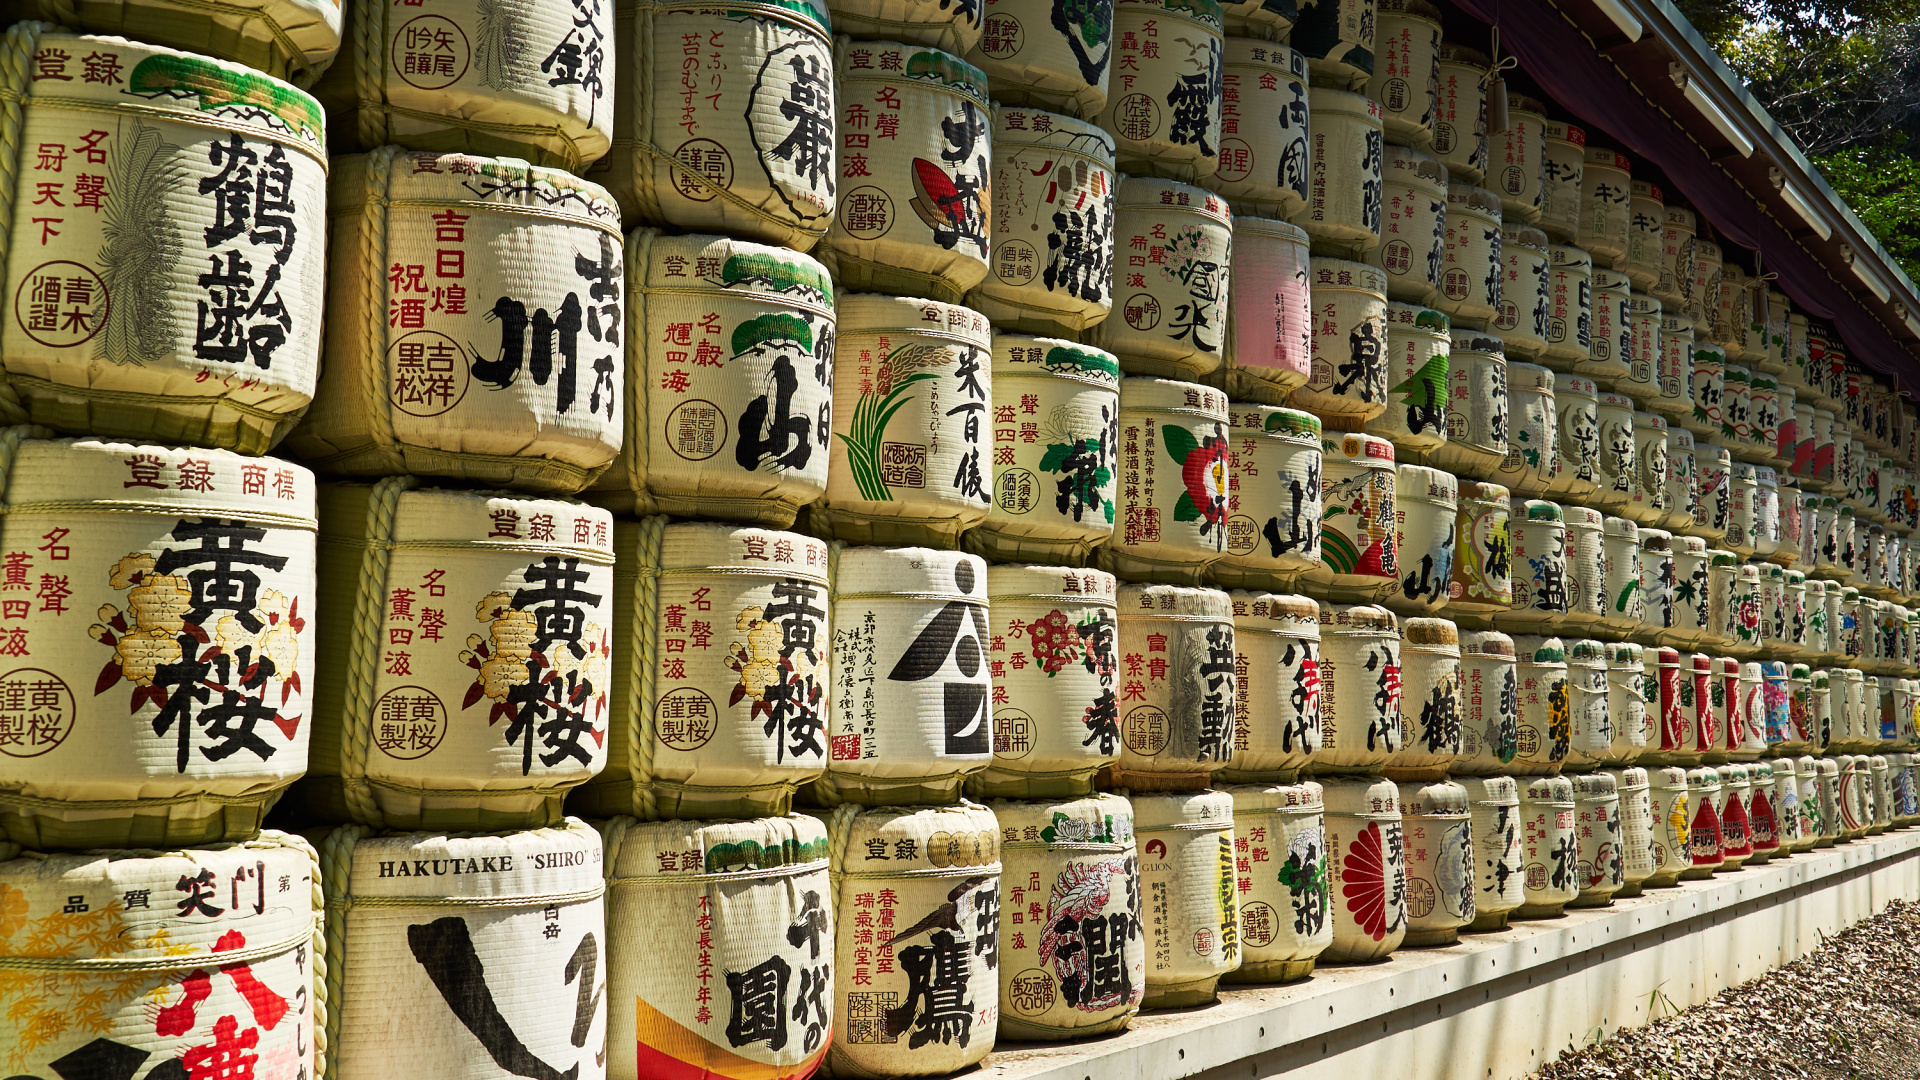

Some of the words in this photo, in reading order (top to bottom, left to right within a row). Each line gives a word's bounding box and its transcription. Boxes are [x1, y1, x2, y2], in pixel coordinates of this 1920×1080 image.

[432, 27, 456, 78] 矢尾
[1000, 19, 1019, 54] 鈴木
[31, 48, 124, 86] 登録
[849, 49, 904, 73] 登録
[1250, 47, 1285, 66] 登録
[1258, 72, 1278, 92] 金
[1004, 111, 1054, 133] 登録
[1121, 95, 1139, 140] 佐浦
[32, 143, 68, 246] 冠天下
[847, 194, 868, 231] 酒造
[868, 194, 887, 231] 牧野
[1159, 190, 1191, 206] 登録
[663, 255, 723, 279] 登録
[1000, 246, 1017, 279] 酒造
[1017, 247, 1034, 280] 柴崎
[1316, 268, 1353, 286] 登録
[28, 276, 59, 332] 酒造
[60, 276, 94, 334] 青木
[388, 262, 429, 329] 祝酒
[661, 322, 694, 394] 輝四海
[1008, 346, 1044, 364] 登録
[394, 342, 425, 406] 黒松
[422, 341, 457, 407] 吉祥
[735, 354, 813, 472] 山
[945, 344, 991, 504] 米百俵
[1241, 440, 1259, 477] 芳名
[1001, 472, 1017, 510] 酒造
[1017, 471, 1032, 513] 久須美
[1123, 425, 1140, 546] 雪椿酒造株式会社
[1239, 521, 1255, 550] 妙高
[1139, 593, 1177, 610] 登録
[1232, 601, 1270, 617] 登録
[1516, 582, 1529, 605] 大洋
[1319, 611, 1352, 626] 登録
[152, 517, 289, 773] 黄桜
[1007, 619, 1030, 671] 芳香
[1145, 632, 1170, 681] 富貴
[505, 556, 603, 776] 黄桜
[763, 578, 826, 765] 黄桜
[27, 679, 65, 747] 黄桜
[1235, 652, 1251, 751] 太田酒造株式会社
[1470, 669, 1484, 721] 長生自得
[379, 695, 409, 751] 謹製
[407, 695, 440, 751] 黄桜
[661, 695, 686, 744] 謹製
[685, 694, 711, 744] 黄桜
[1526, 729, 1538, 753] 多胡
[1594, 807, 1608, 822] 酒
[865, 838, 919, 861] 登録
[1002, 825, 1041, 844] 登録
[1693, 834, 1716, 847] FUJI
[378, 854, 514, 878] HAKUTAKE
[656, 850, 705, 873] 登録
[176, 860, 266, 918] 笑門
[543, 903, 562, 940] 白岳
[1241, 911, 1257, 940] 酒造
